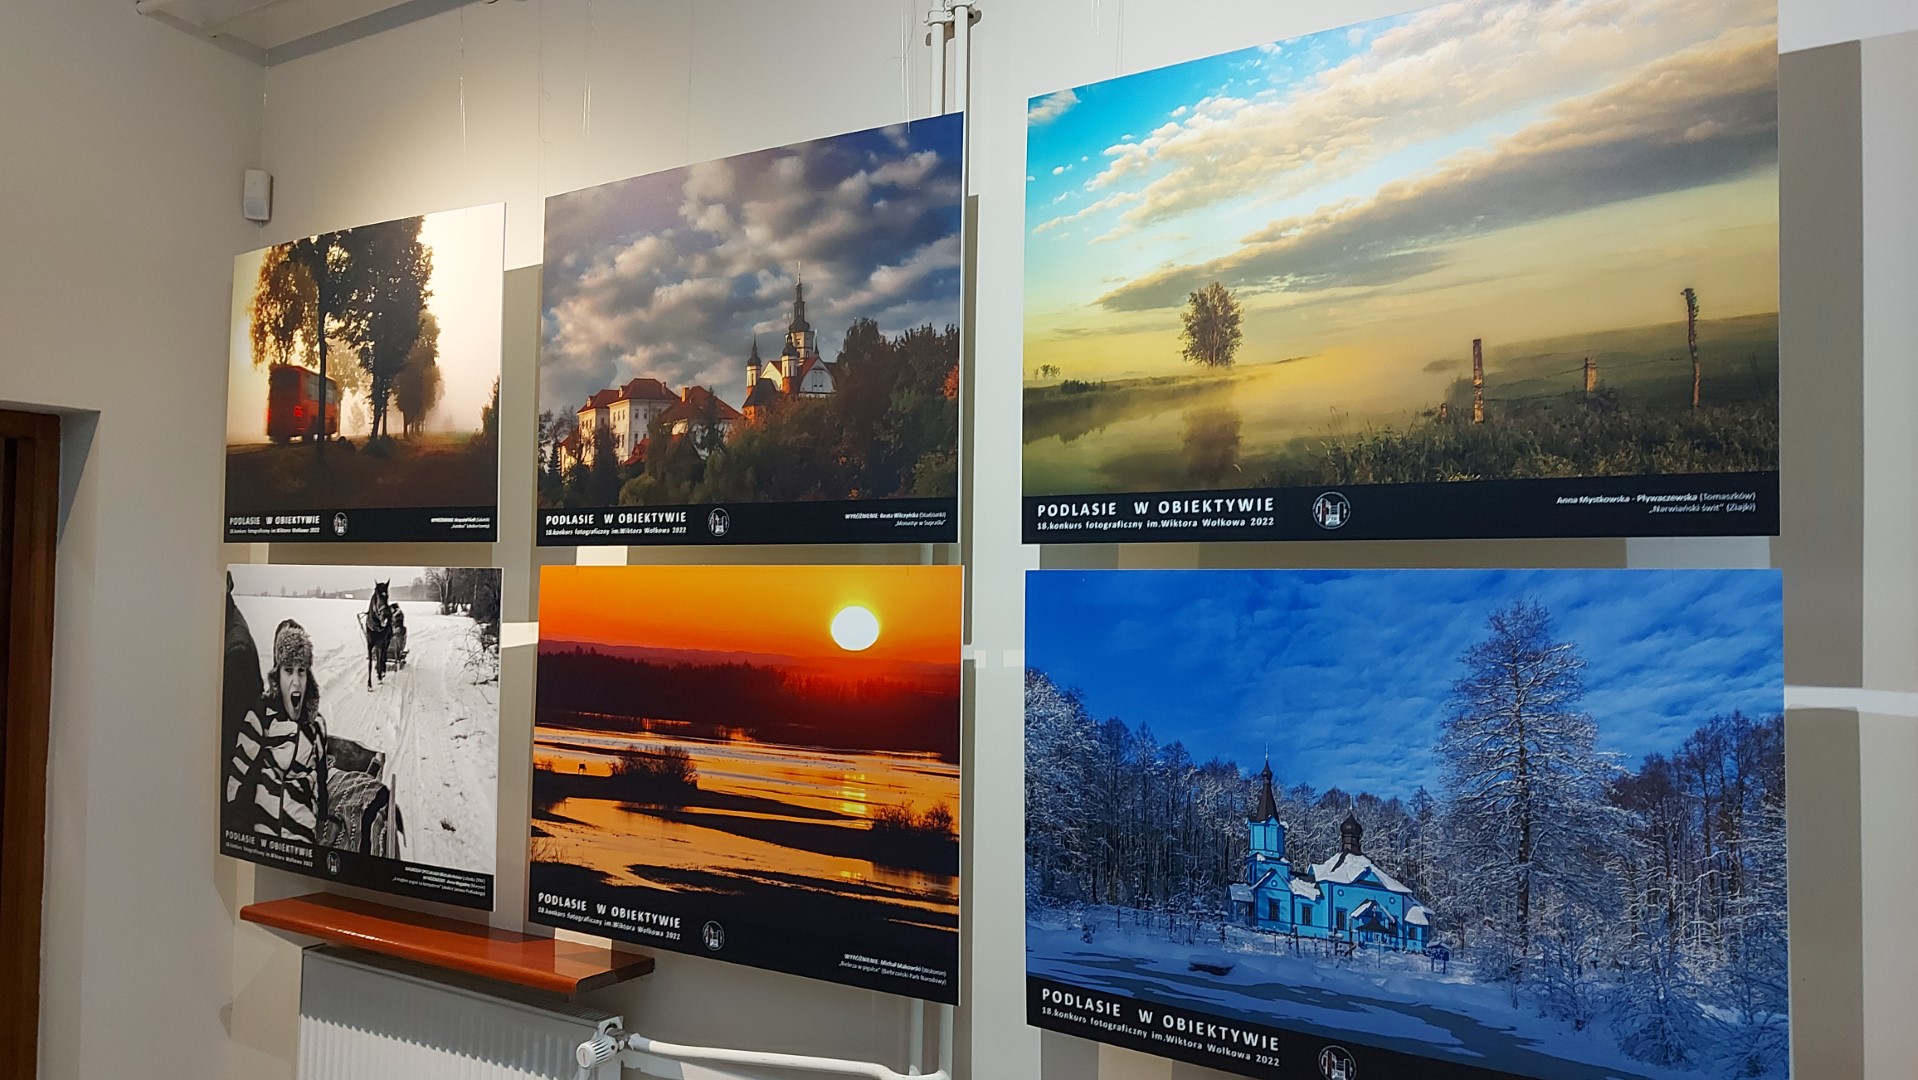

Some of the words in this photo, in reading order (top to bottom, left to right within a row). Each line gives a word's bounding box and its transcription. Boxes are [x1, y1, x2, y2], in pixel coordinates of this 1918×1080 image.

[1037, 502, 1117, 517] PODLASIE
[1134, 502, 1149, 515] W
[1158, 497, 1274, 514] OBIEKTYWIE
[1556, 496, 1578, 505] Anna
[275, 516, 319, 524] OBIEKTYWIE
[546, 515, 594, 525] PODLASIE
[604, 513, 613, 523] W
[619, 512, 686, 523] OBIEKTYWIE
[1037, 521, 1082, 530] 18.konkurs
[1085, 519, 1143, 530] fotograficzny
[1250, 516, 1275, 526] 2022
[226, 830, 255, 844] PODLASIE
[261, 839, 267, 847] W
[268, 840, 313, 858] OBIEKTYWIE
[538, 892, 587, 912] PODLASIE
[596, 903, 607, 915] W
[611, 906, 681, 929] OBIEKTYWIE
[1042, 988, 1121, 1017] PODLASIE
[1138, 1008, 1153, 1024] W
[1162, 1014, 1279, 1051] OBIEKTYWIE
[1041, 1006, 1087, 1024] 18.konkurs
[1090, 1017, 1148, 1039] fotograficzny
[1255, 1054, 1280, 1067] 2022
